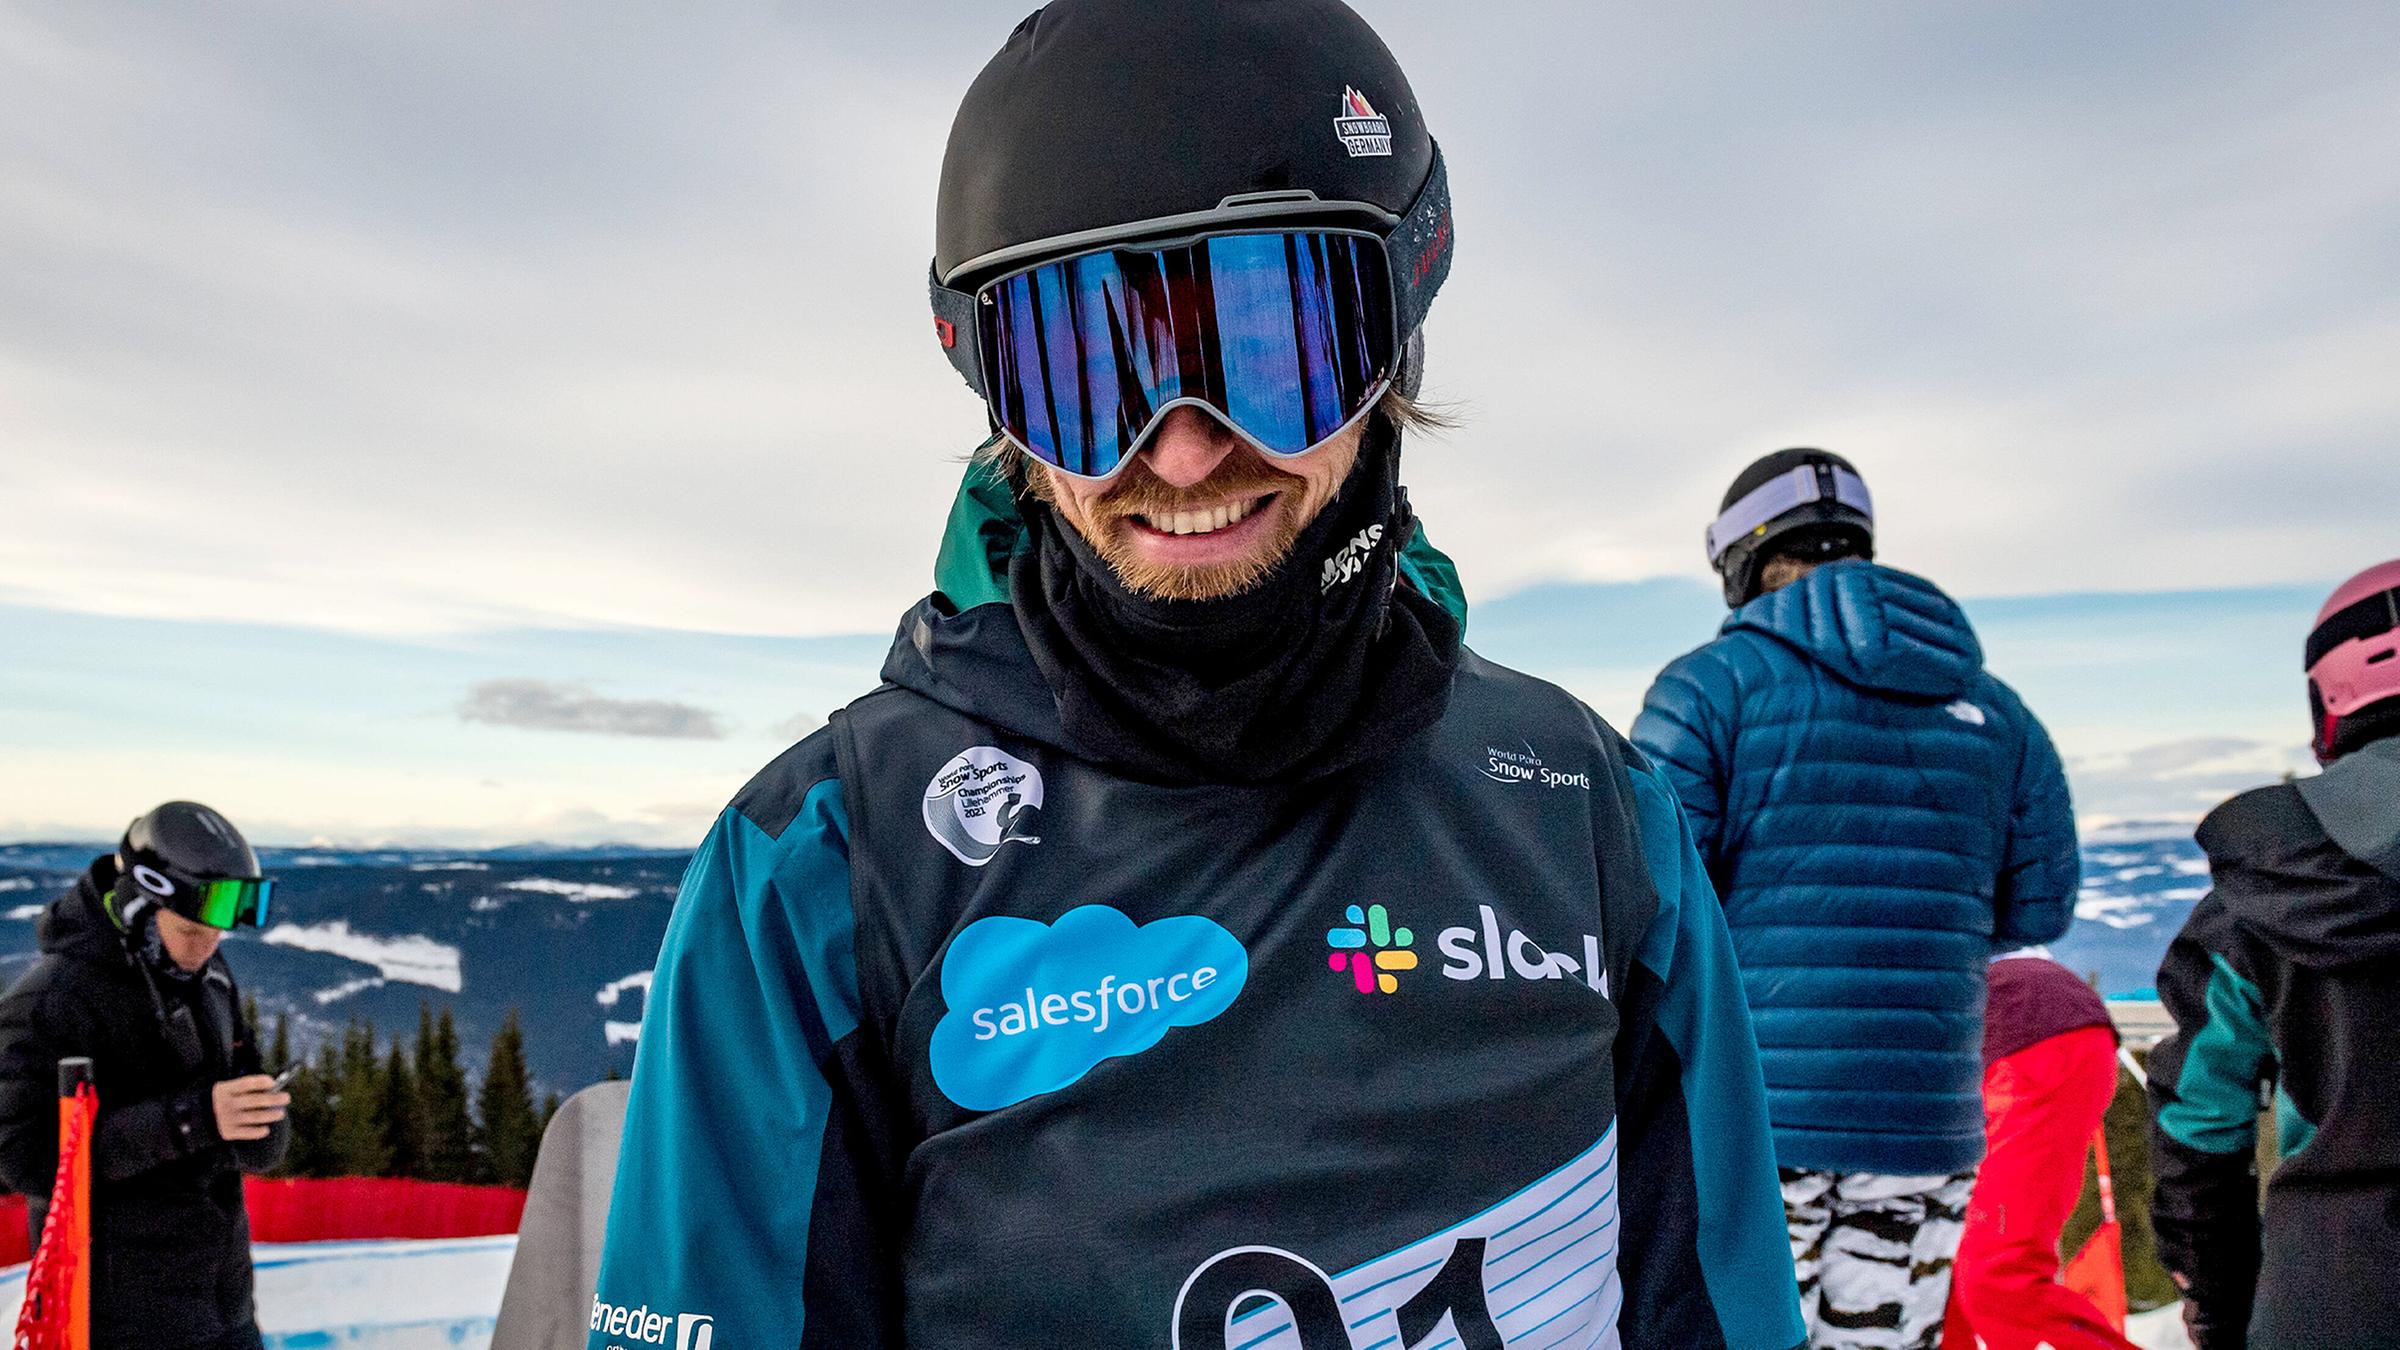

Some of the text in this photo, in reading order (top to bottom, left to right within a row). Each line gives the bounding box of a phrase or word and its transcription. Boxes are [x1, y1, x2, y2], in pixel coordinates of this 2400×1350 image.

[1341, 121, 1387, 135] SNOWBOARD
[1347, 138, 1391, 155] GERMANY
[1486, 746, 1542, 766] World Para
[940, 761, 1009, 792] Snow Sports
[1488, 757, 1590, 790] Snow Sports
[958, 774, 1027, 797] Championships
[964, 807, 987, 818] 2021
[972, 966, 1217, 1041] salesforce
